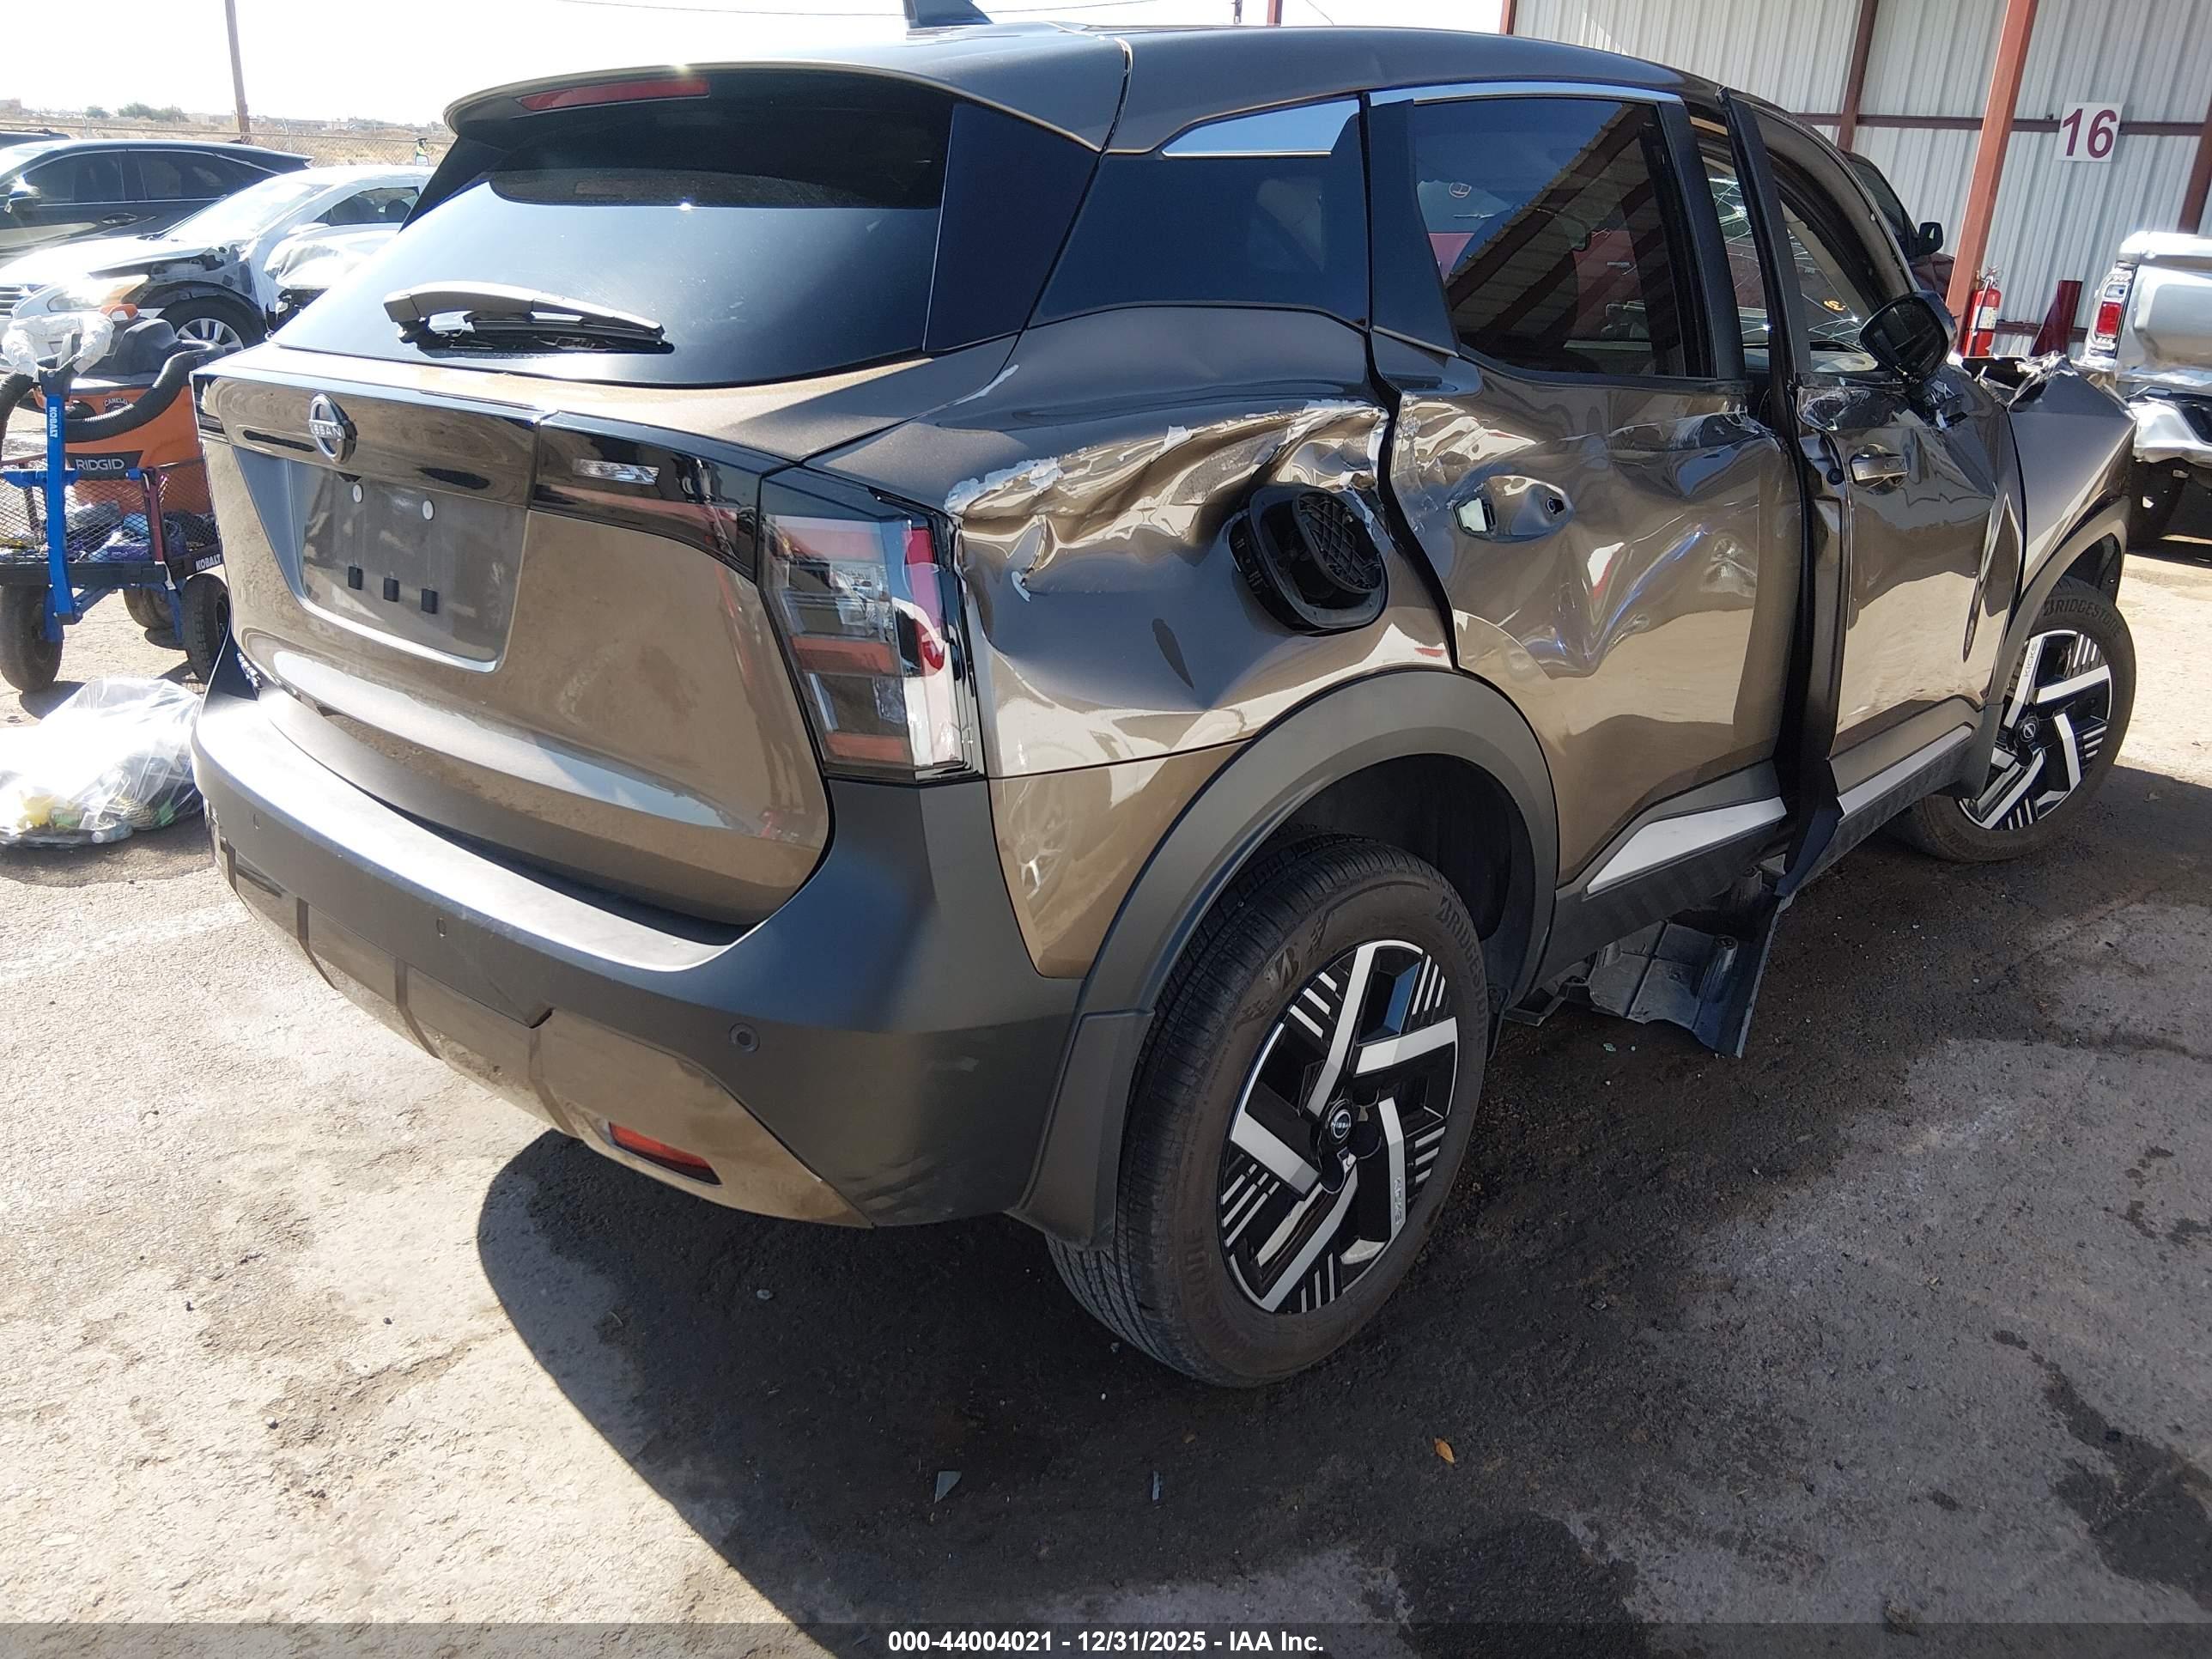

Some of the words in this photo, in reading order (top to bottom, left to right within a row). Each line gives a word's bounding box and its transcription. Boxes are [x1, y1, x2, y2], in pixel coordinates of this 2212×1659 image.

[2062, 109, 2116, 159] 16
[49, 406, 58, 438] KOBALT
[309, 424, 342, 438] SSAN
[76, 459, 125, 471] RIDGID
[195, 553, 222, 572] KOBALT
